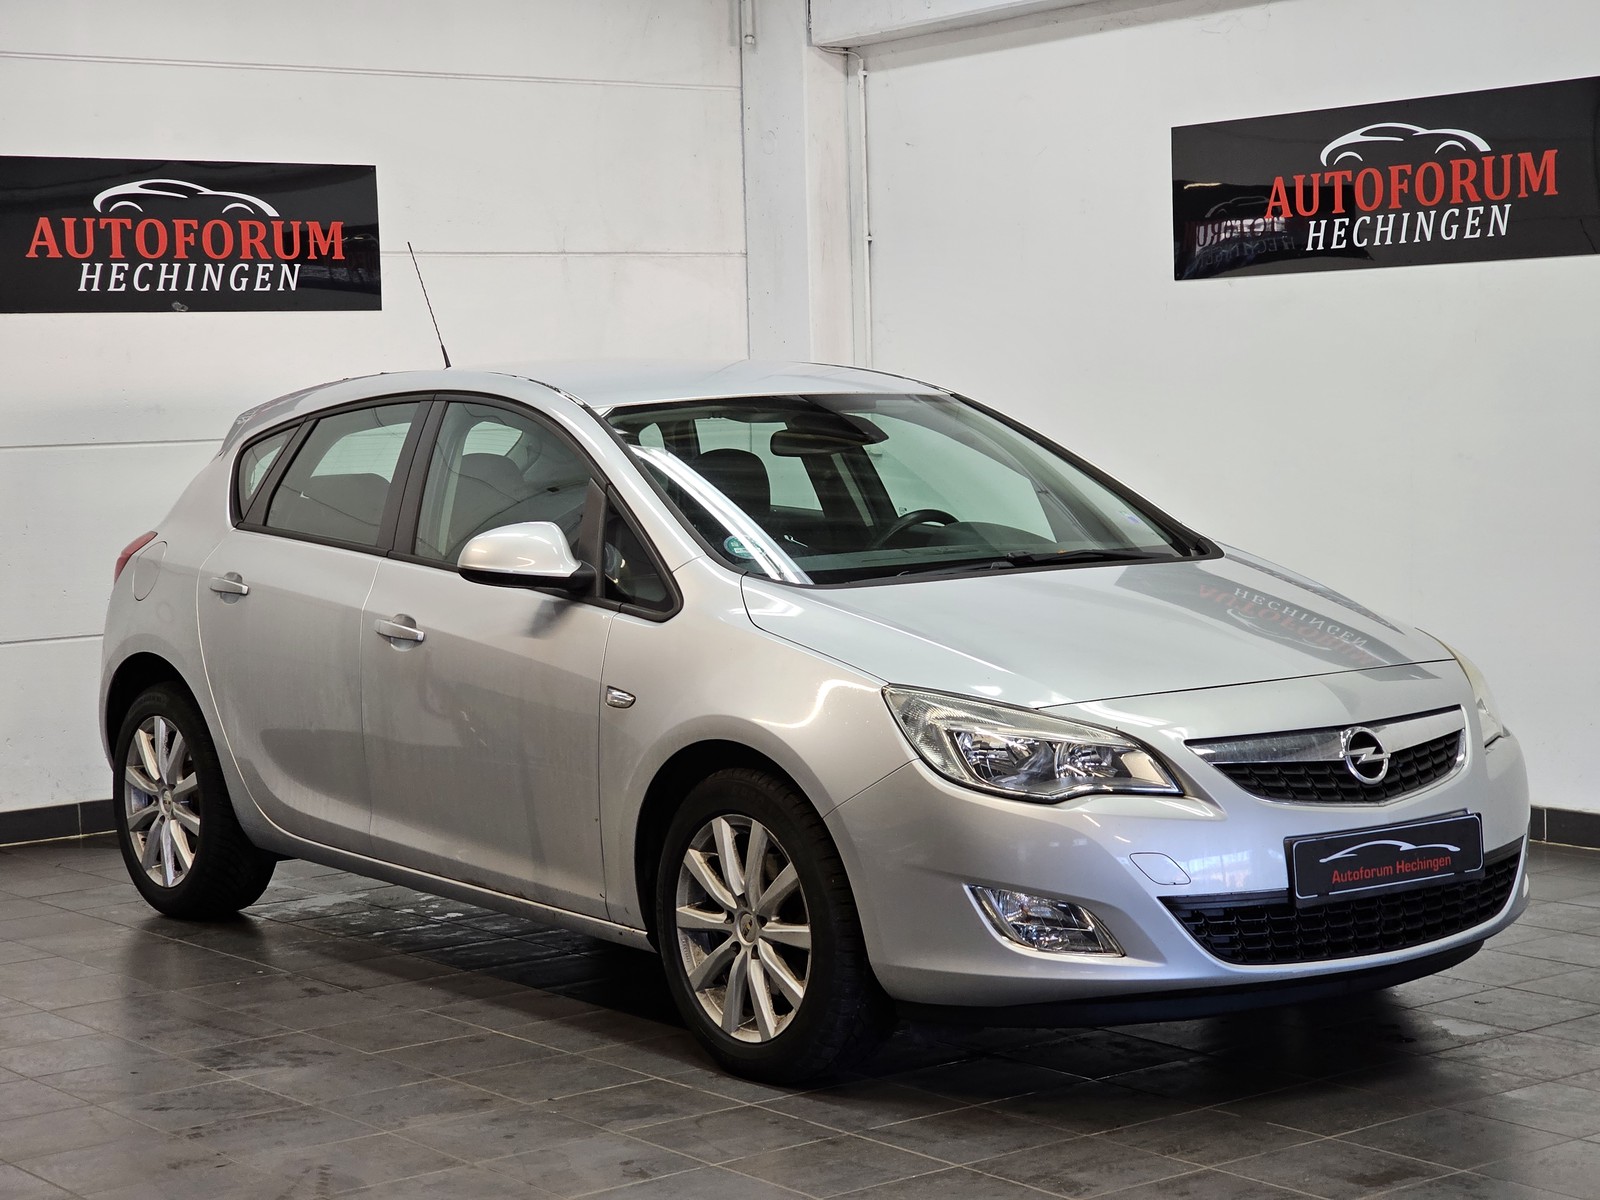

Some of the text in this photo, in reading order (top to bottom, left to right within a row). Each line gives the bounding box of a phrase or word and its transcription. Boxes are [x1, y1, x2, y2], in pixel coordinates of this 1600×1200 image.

[1264, 149, 1559, 219] AUTOFORUM
[25, 216, 346, 260] AUTOFORUM
[1305, 204, 1512, 251] HECHINGEN
[77, 262, 301, 292] HECHINGEN
[1331, 855, 1451, 884] Autoforum Hechingen
